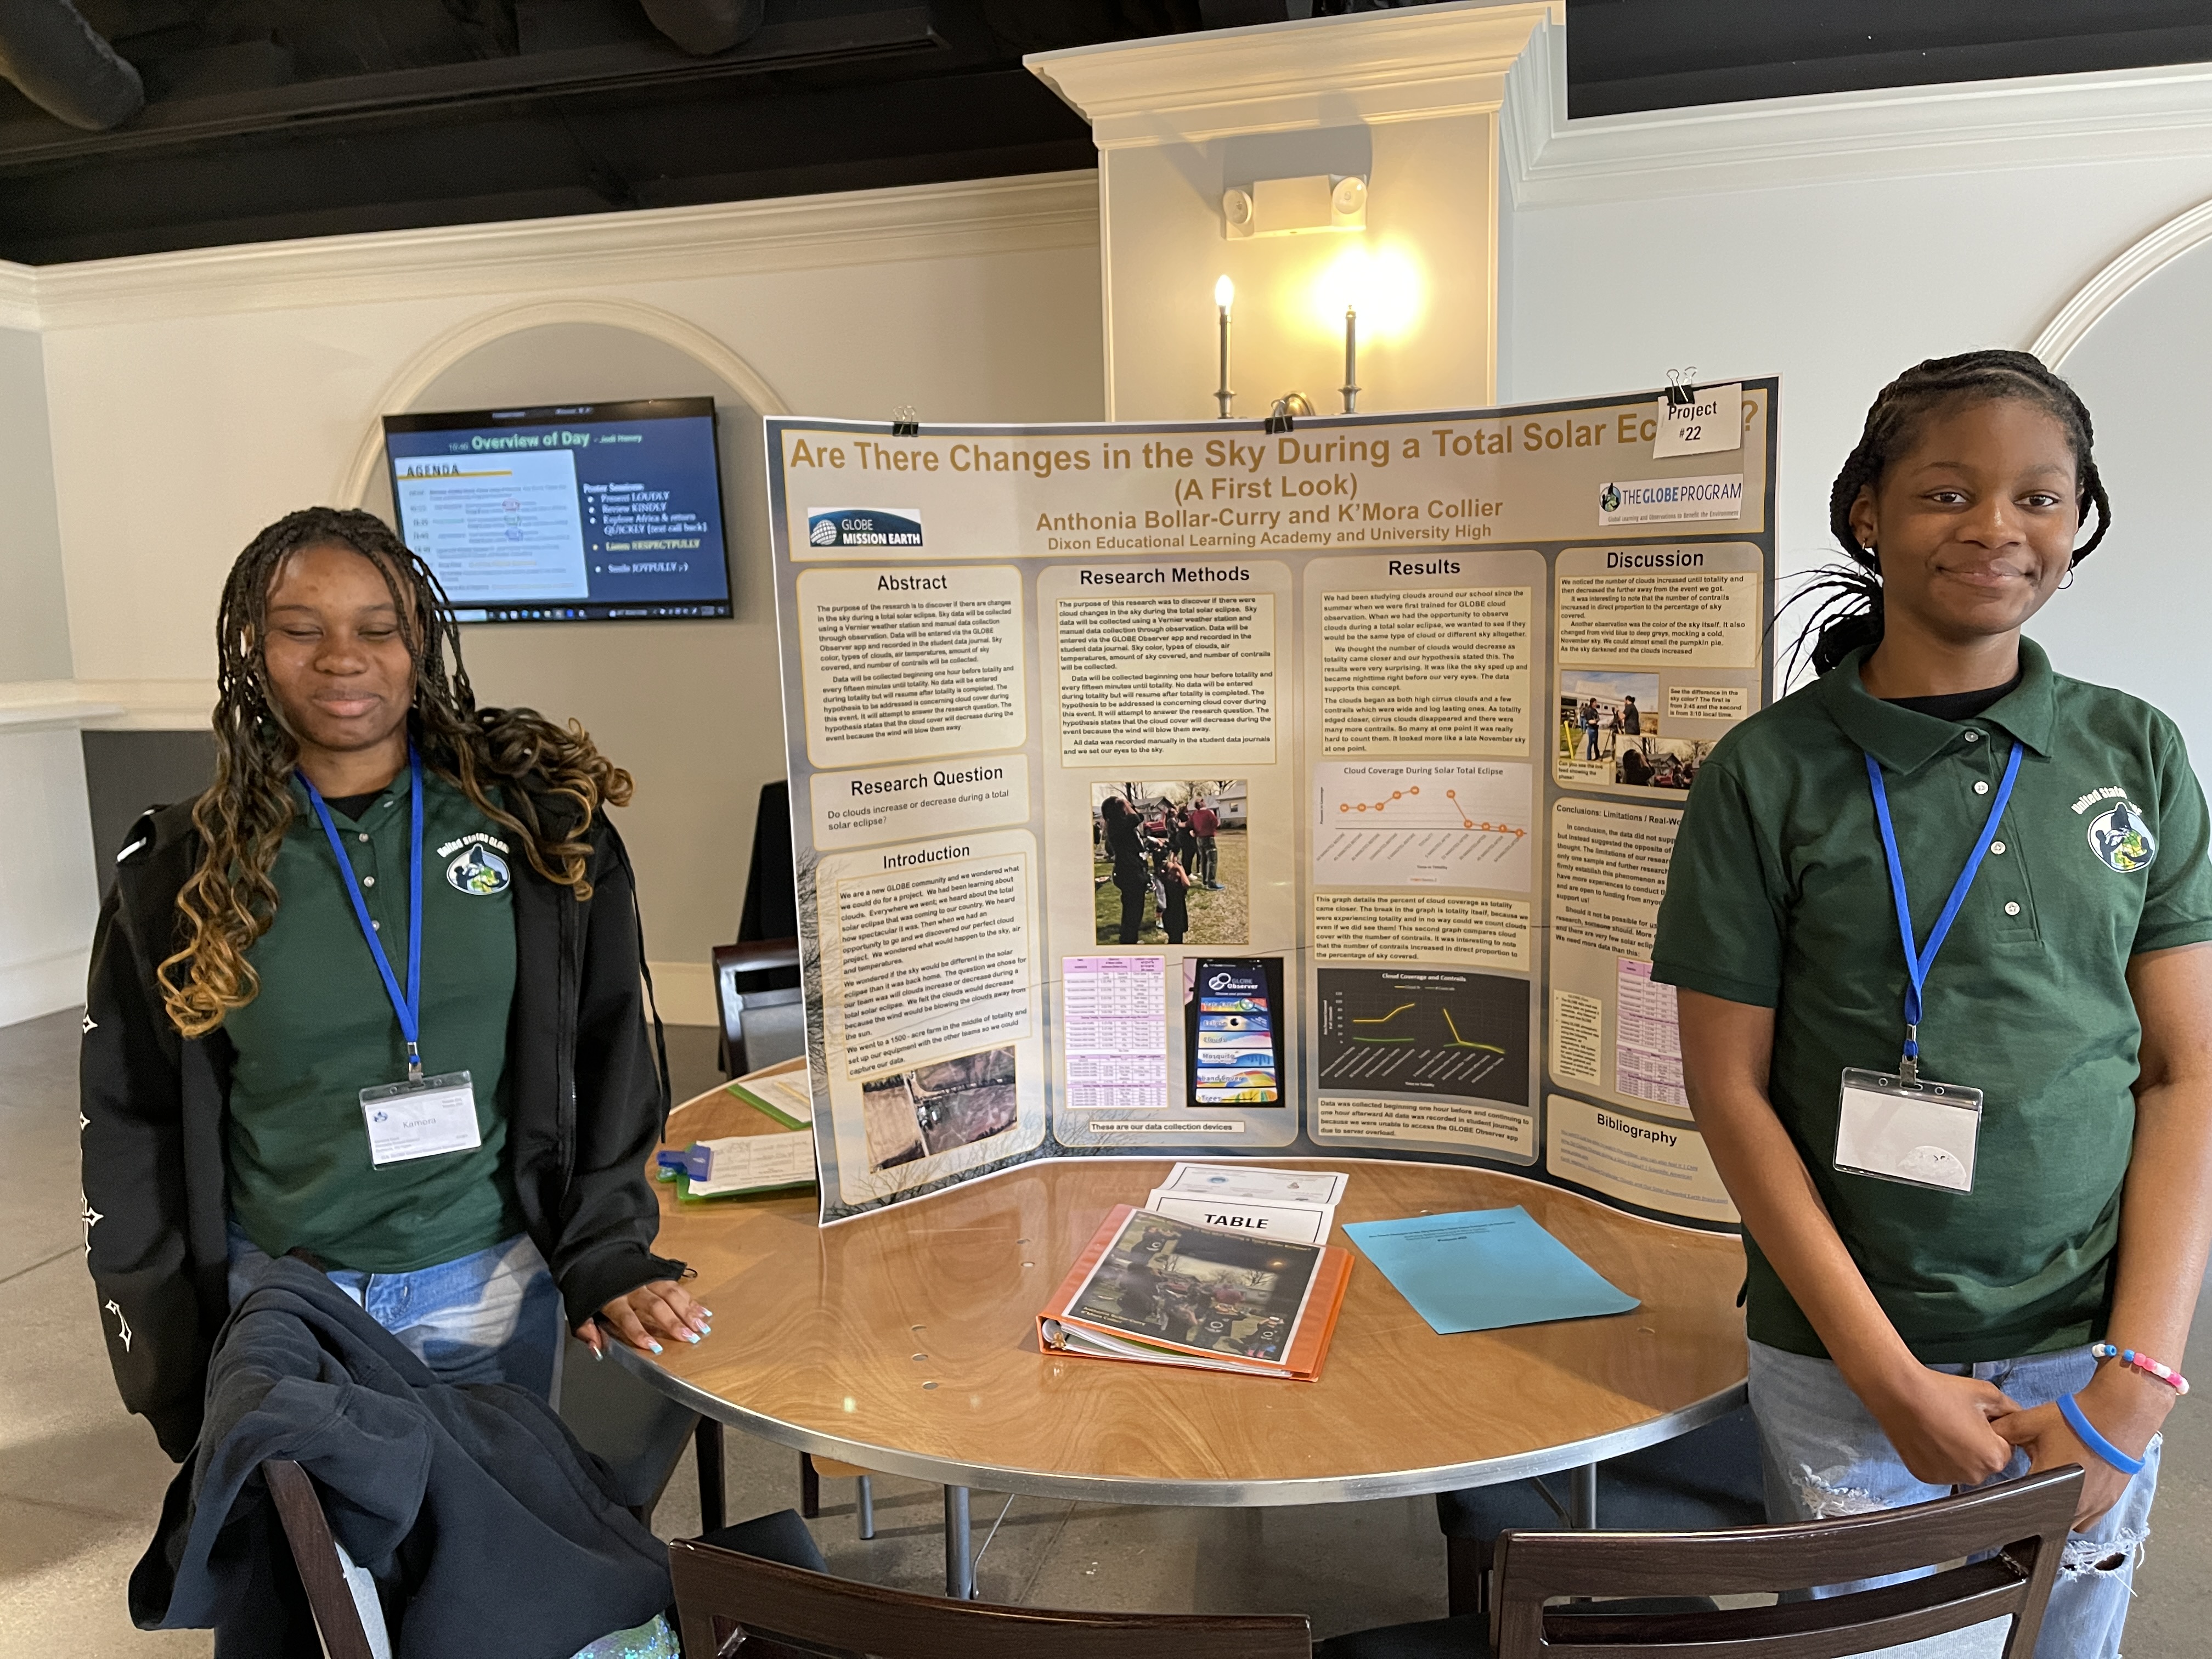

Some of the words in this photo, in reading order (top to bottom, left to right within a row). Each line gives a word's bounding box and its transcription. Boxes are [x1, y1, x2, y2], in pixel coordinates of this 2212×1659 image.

[1668, 401, 1717, 420] Project
[471, 433, 539, 450] Overview
[542, 431, 558, 446] of
[561, 431, 590, 448] Day
[1679, 425, 1701, 441] #22
[790, 438, 845, 469] Are
[854, 441, 939, 471] There
[950, 442, 1090, 478] Changes
[1103, 442, 1131, 470] in
[1142, 441, 1193, 469] the
[1205, 439, 1265, 473] Sky
[1278, 435, 1389, 467] During
[1402, 438, 1420, 459] a
[1432, 424, 1512, 457] Total
[1523, 420, 1606, 451] Solar
[407, 464, 460, 476] AGENDA
[631, 491, 669, 501] LOUDLY
[1175, 478, 1203, 505] (A
[1211, 477, 1272, 499] First
[1281, 472, 1357, 498] Look)
[1036, 511, 1137, 532] Anthonia
[1145, 508, 1280, 530] Bollar-Curry
[1288, 504, 1329, 524] and
[1427, 498, 1503, 518] Collier
[841, 518, 873, 531] GLOBE
[843, 533, 887, 544] MISSION
[888, 533, 921, 544] EARTH
[1048, 537, 1091, 550] Dixon
[1096, 534, 1184, 549] Educational
[1189, 533, 1256, 548] Learning
[1260, 531, 1331, 545] Academy
[1336, 527, 1365, 542] and
[1370, 526, 1449, 541] University
[1455, 523, 1491, 540] High
[1389, 559, 1460, 575] Results
[1607, 550, 1703, 568] Discussion
[877, 575, 947, 591] Abstract
[1080, 568, 1165, 585] Research
[1172, 566, 1249, 582] Methods
[1703, 575, 1728, 584] totality
[1368, 767, 1404, 776] Coverage
[1406, 766, 1432, 775] During
[1434, 766, 1454, 774] Solar
[1477, 767, 1503, 776] Eclipse
[851, 774, 928, 795] Research
[933, 766, 1003, 786] Question
[827, 810, 840, 819] Do
[842, 806, 871, 817] clouds
[873, 803, 908, 814] increase
[920, 797, 956, 808] decrease
[958, 793, 983, 803] during
[991, 789, 1009, 798] total
[828, 821, 851, 831] solar
[853, 816, 887, 827] eclipse?
[1603, 810, 1643, 822] Limitations
[1644, 814, 1647, 822] /
[883, 845, 969, 868] Introduction
[886, 881, 910, 892] GLOBE
[911, 877, 946, 888] community
[947, 873, 960, 882] and
[970, 867, 1002, 878] wondered
[1489, 901, 1513, 910] totality
[402, 1118, 436, 1128] Kamora
[1597, 1113, 1677, 1147] Bibliography
[1205, 1214, 1269, 1229] TABLE
